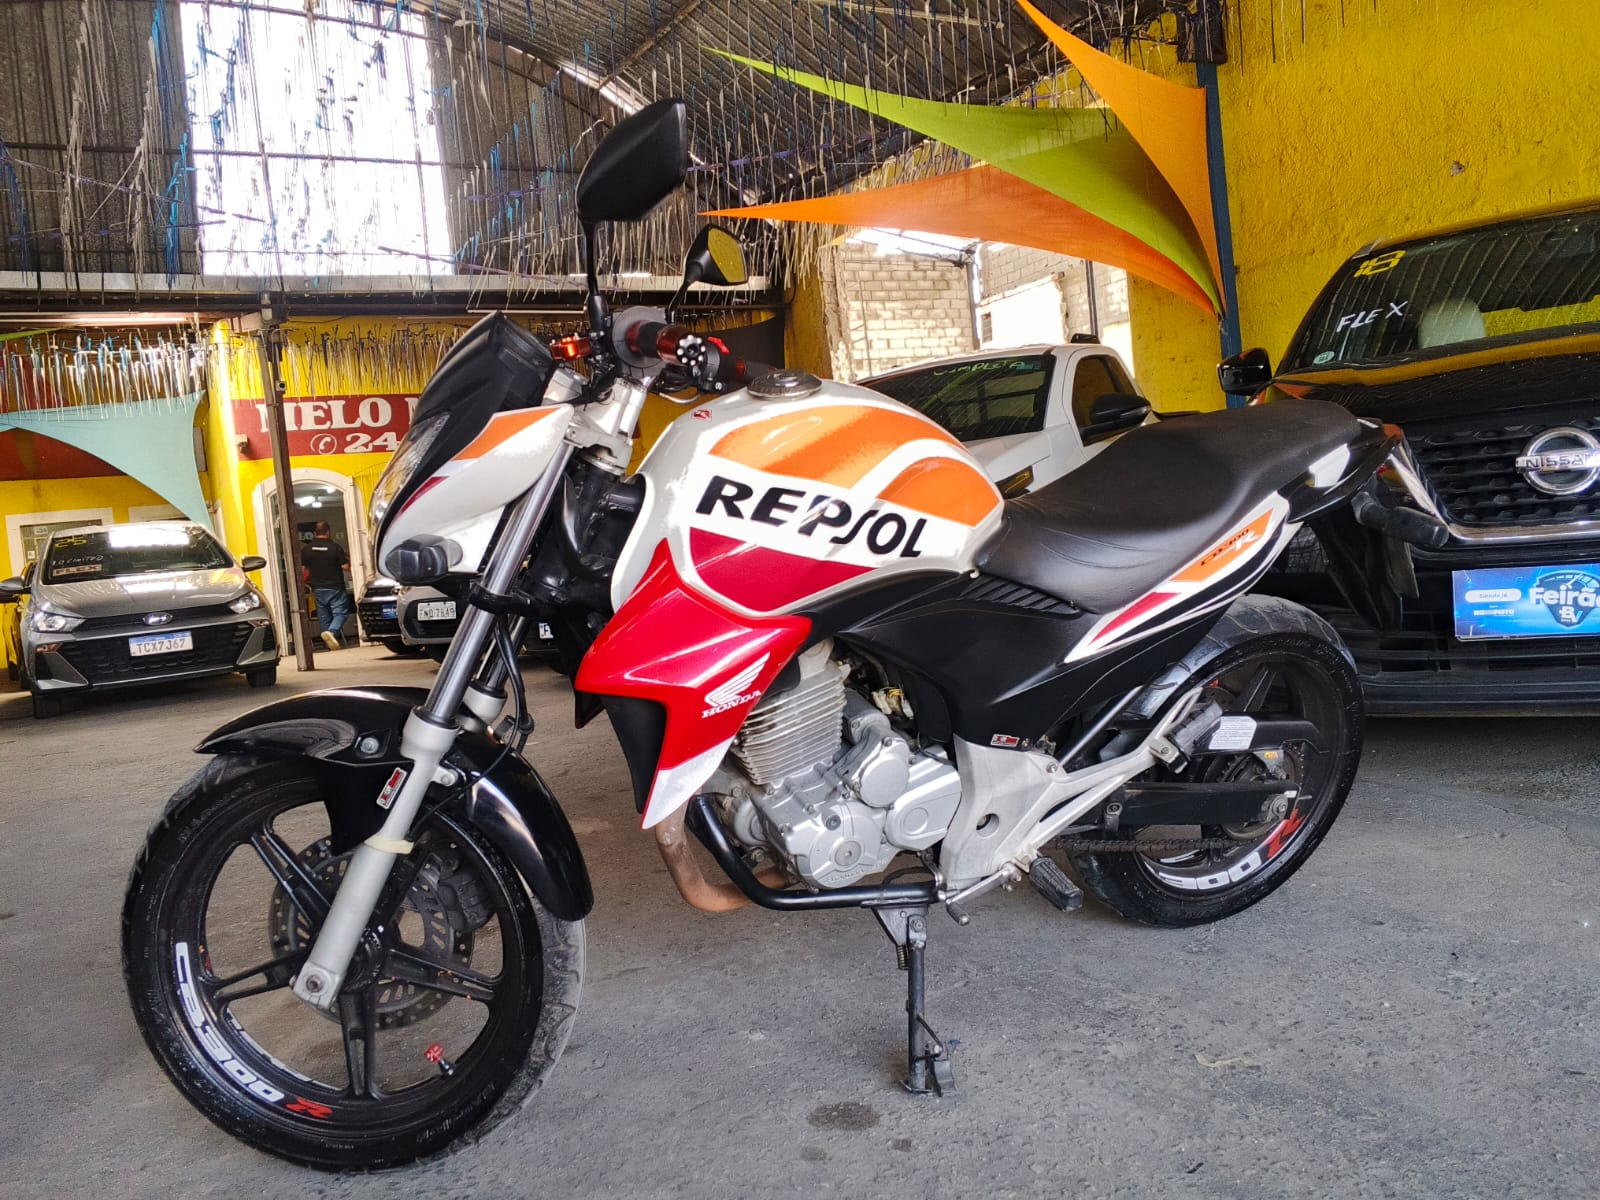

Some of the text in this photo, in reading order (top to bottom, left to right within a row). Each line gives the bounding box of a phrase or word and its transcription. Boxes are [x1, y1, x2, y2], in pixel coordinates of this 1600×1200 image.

[695, 475, 928, 558] REPSOL
[1529, 584, 1600, 608] Feirã
[701, 690, 762, 718] HONDA
